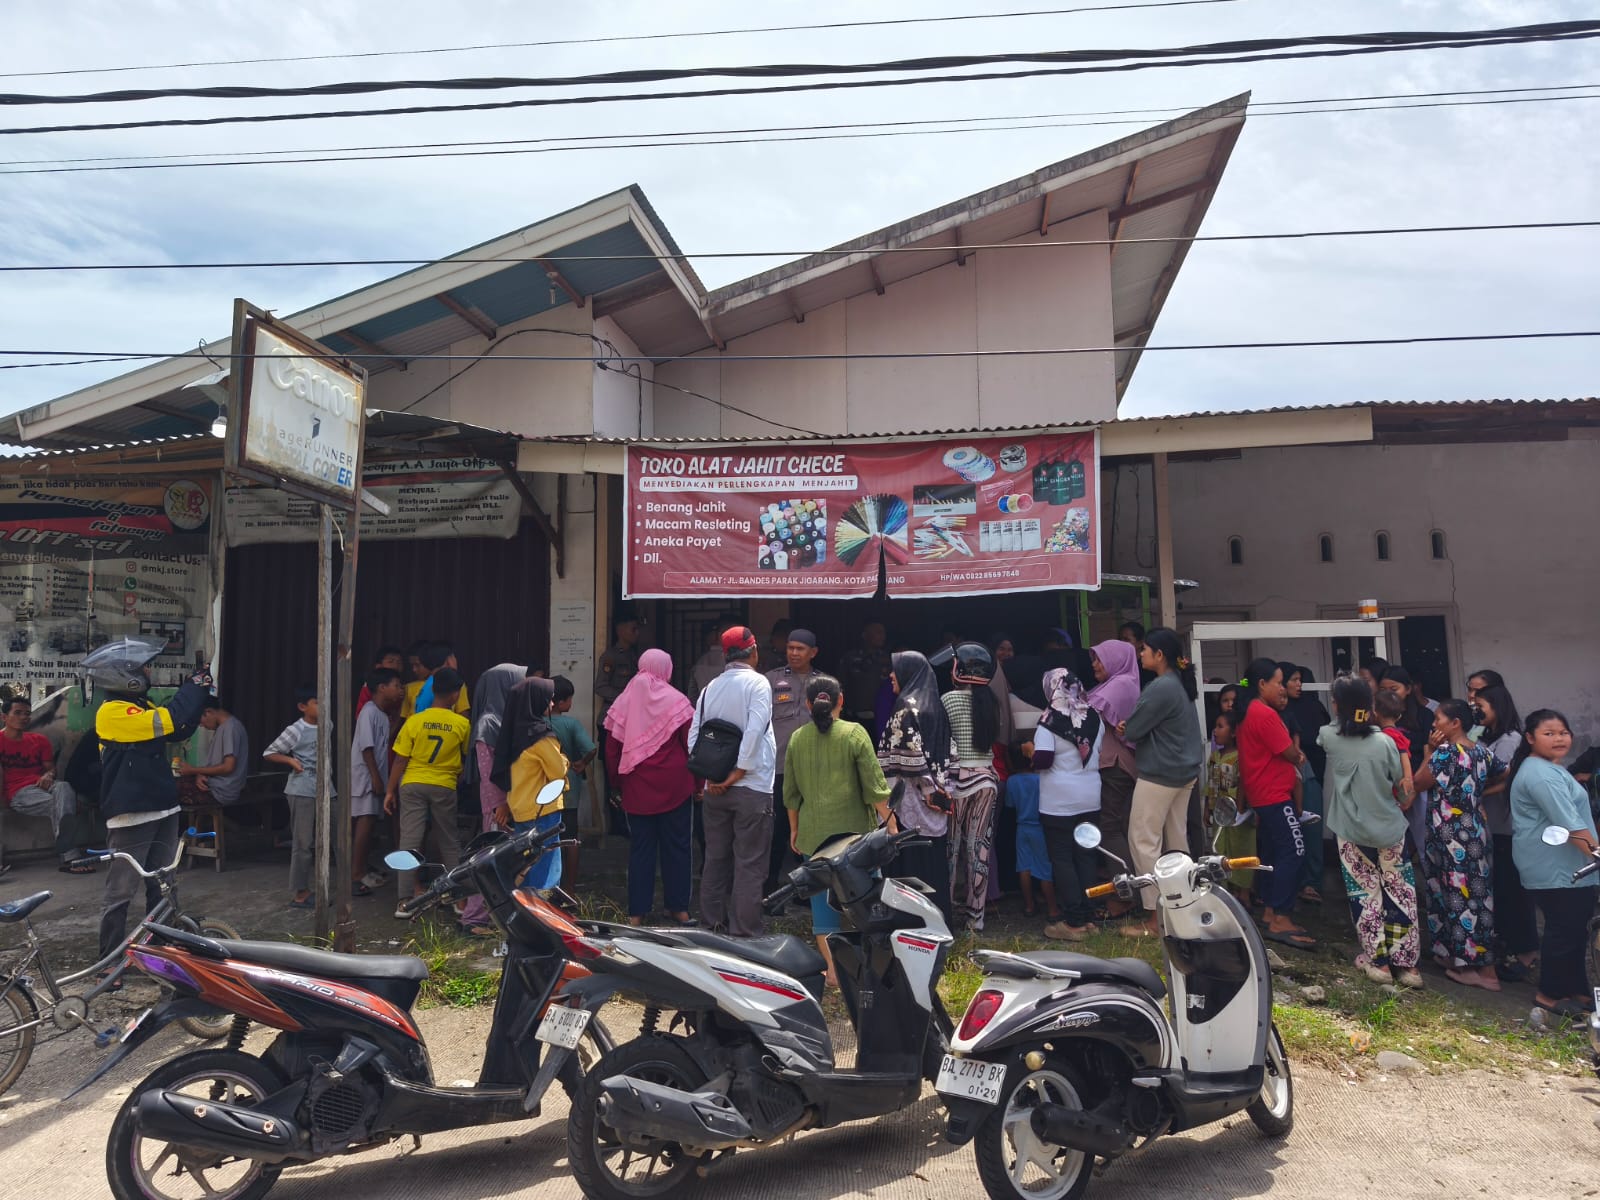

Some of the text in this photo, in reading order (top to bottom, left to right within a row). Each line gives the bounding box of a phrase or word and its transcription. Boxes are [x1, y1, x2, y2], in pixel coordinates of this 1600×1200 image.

[640, 454, 845, 475] TOKO ALAT JAHIT CHECE
[643, 479, 854, 489] MENYEDIAKAN PERLENGKAPAN MENJAHIT
[646, 502, 726, 515] Benang Jahit
[645, 519, 751, 532] Macam Resleting
[644, 536, 722, 549] Aneka Payet
[132, 549, 182, 563] Contact
[739, 576, 770, 585] BANDES
[771, 576, 799, 585] PARAK
[844, 576, 866, 585] KOTA
[423, 721, 453, 732] RONALDO
[427, 734, 444, 764] 7
[1283, 805, 1306, 857] adidas
[908, 945, 931, 954] HONDA
[942, 1057, 1004, 1083] BA 2719 BK
